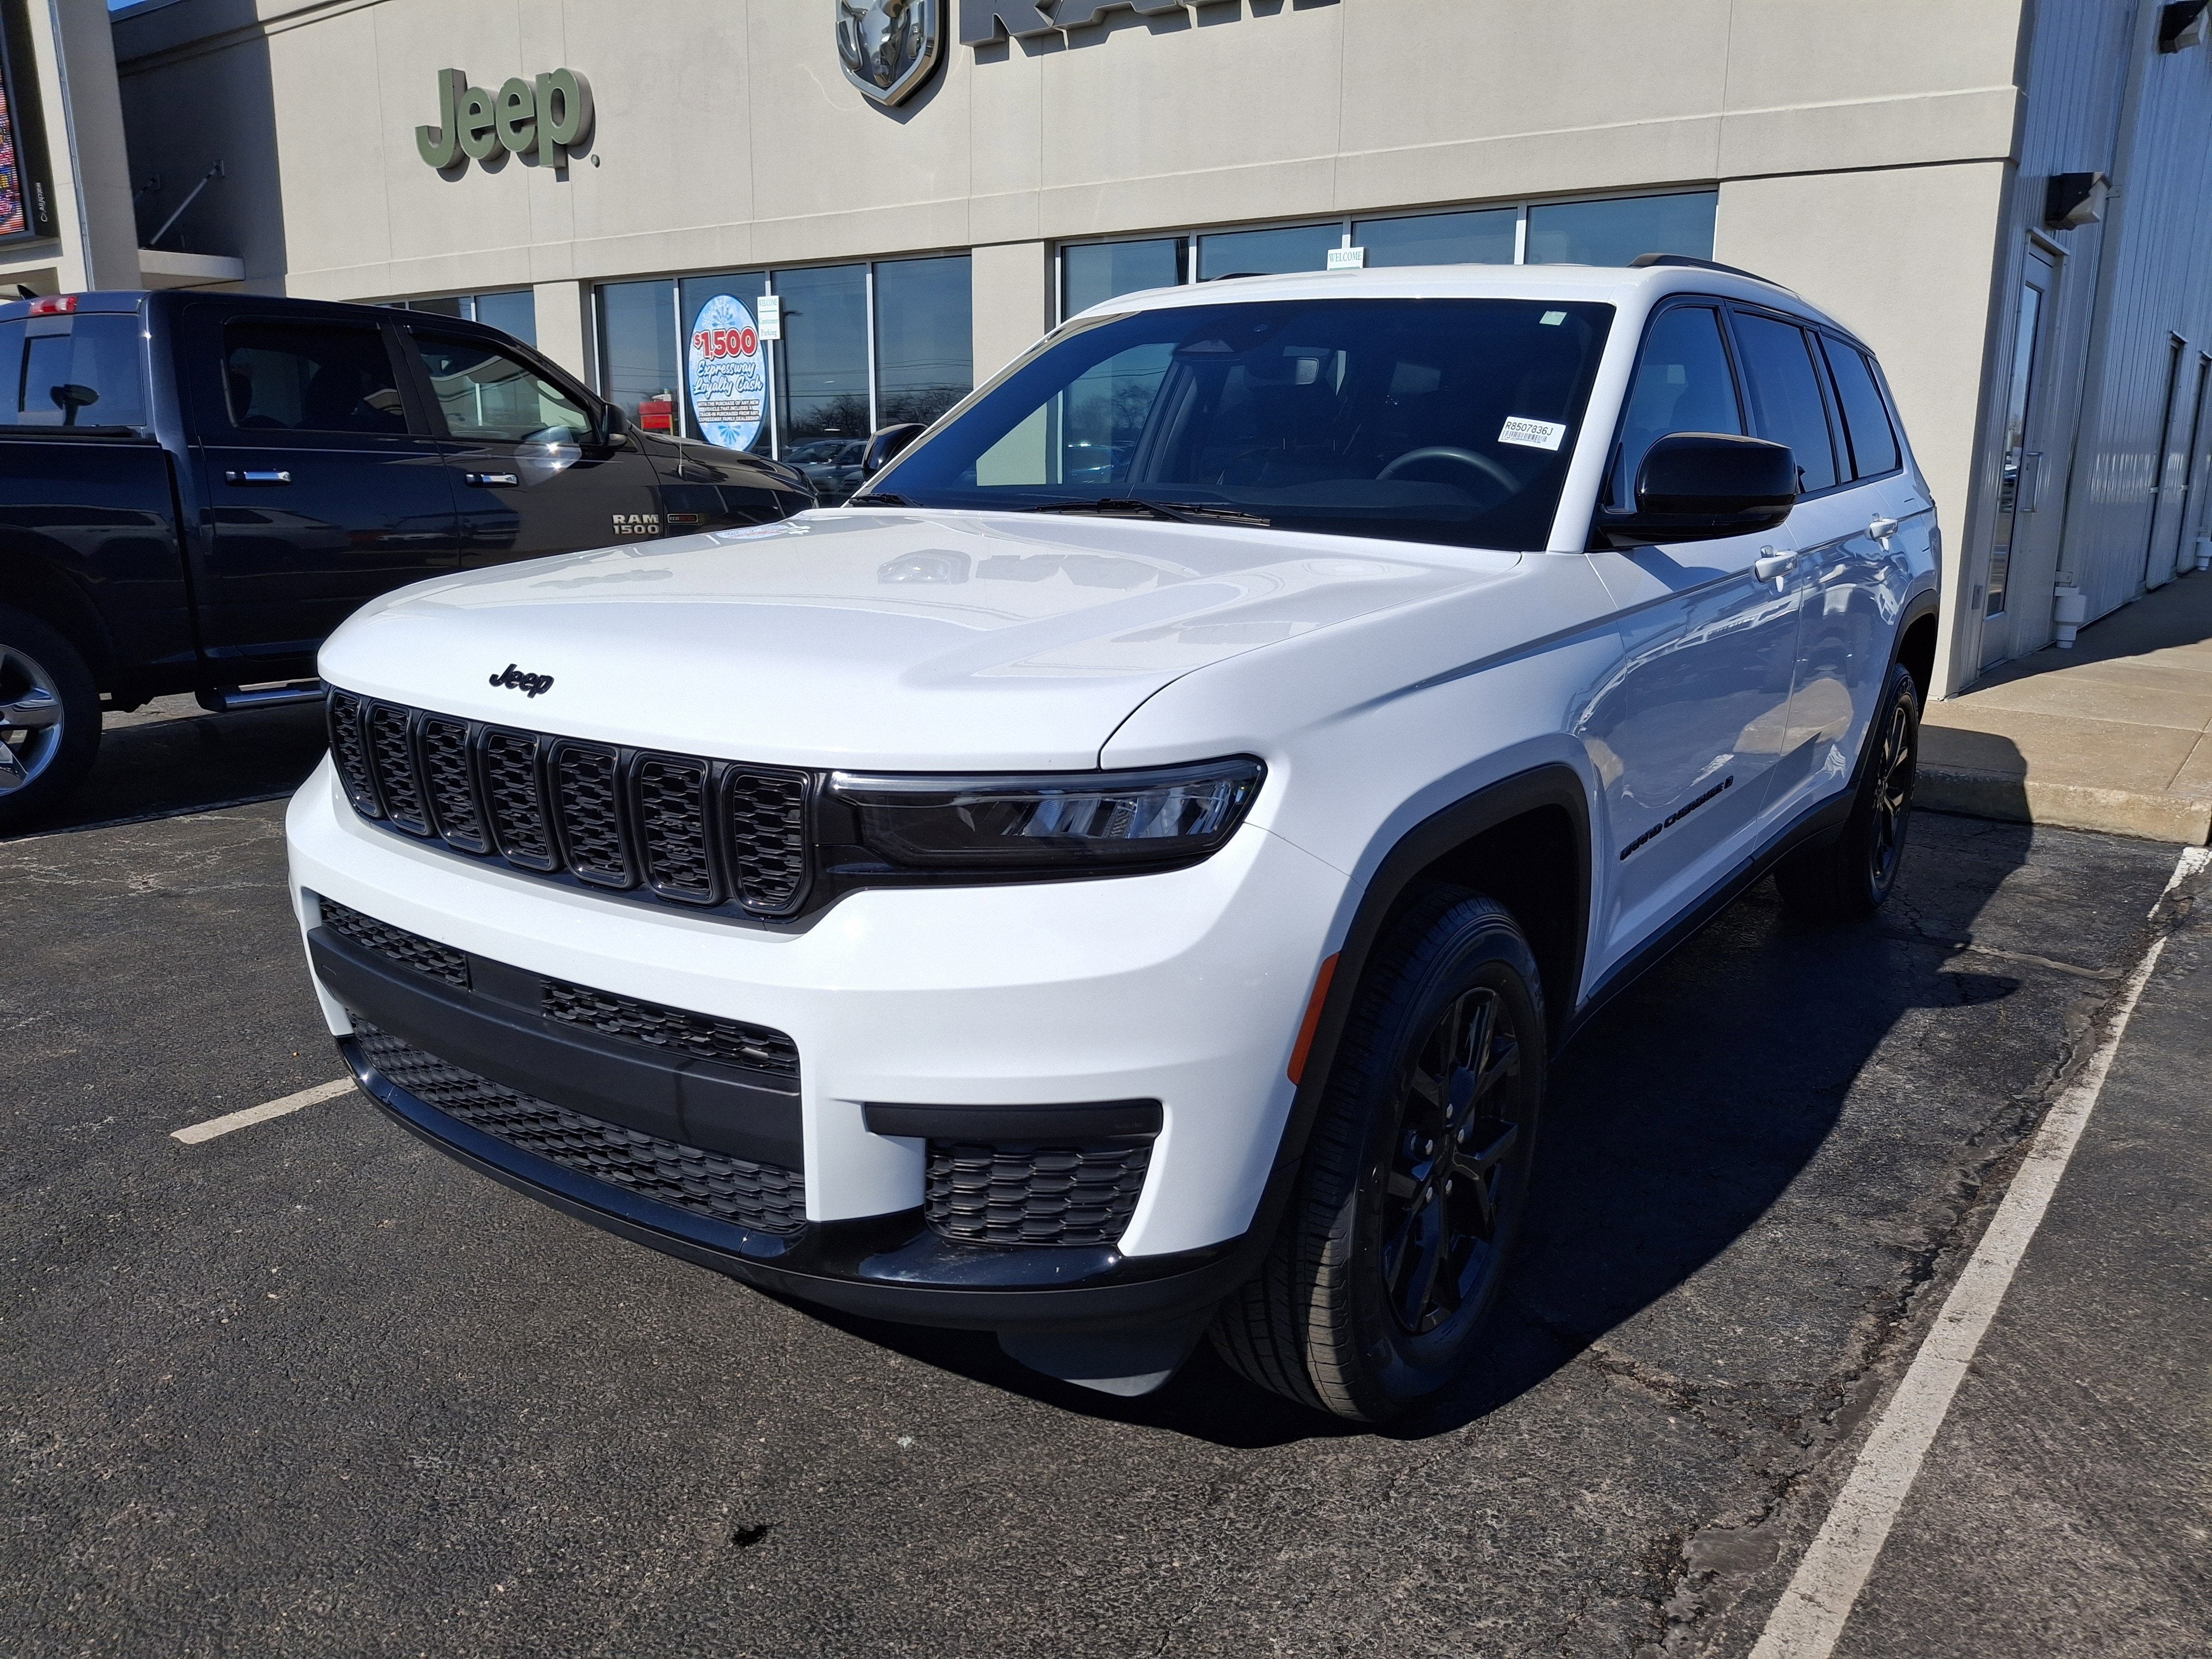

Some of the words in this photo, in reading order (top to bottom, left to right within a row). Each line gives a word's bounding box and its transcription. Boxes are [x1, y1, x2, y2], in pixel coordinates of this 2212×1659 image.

[415, 67, 594, 169] Jeep
[1329, 251, 1362, 262] WELCOME
[761, 329, 777, 338] Parking
[693, 326, 757, 361] $1,500
[697, 359, 756, 381] Expressway
[692, 376, 734, 400] Loyalty
[735, 374, 763, 393] Cash
[1505, 421, 1553, 435] R8507836J
[612, 515, 659, 524] RAM
[613, 524, 659, 535] 1500
[489, 664, 554, 699] Jeep
